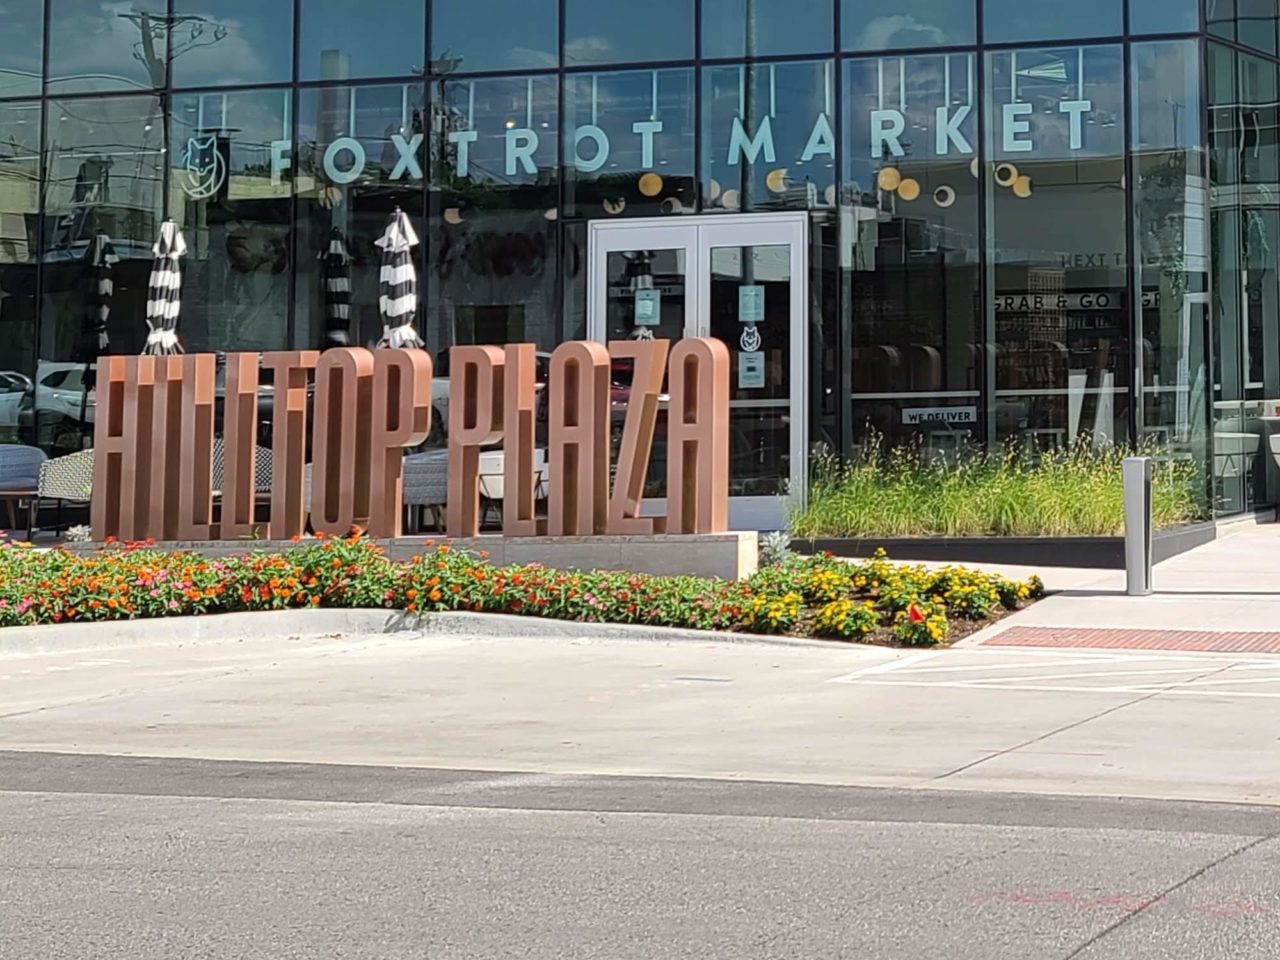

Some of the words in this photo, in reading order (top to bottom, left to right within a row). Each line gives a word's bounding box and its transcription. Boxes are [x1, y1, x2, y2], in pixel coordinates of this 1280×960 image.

[271, 121, 664, 186] FOXTROT
[727, 100, 1091, 167] MARKET
[1080, 293, 1110, 309] GO
[91, 346, 432, 540] HILLTOP
[447, 336, 729, 539] PLAZA
[908, 413, 924, 422] WE
[927, 411, 971, 422] DELIVER
